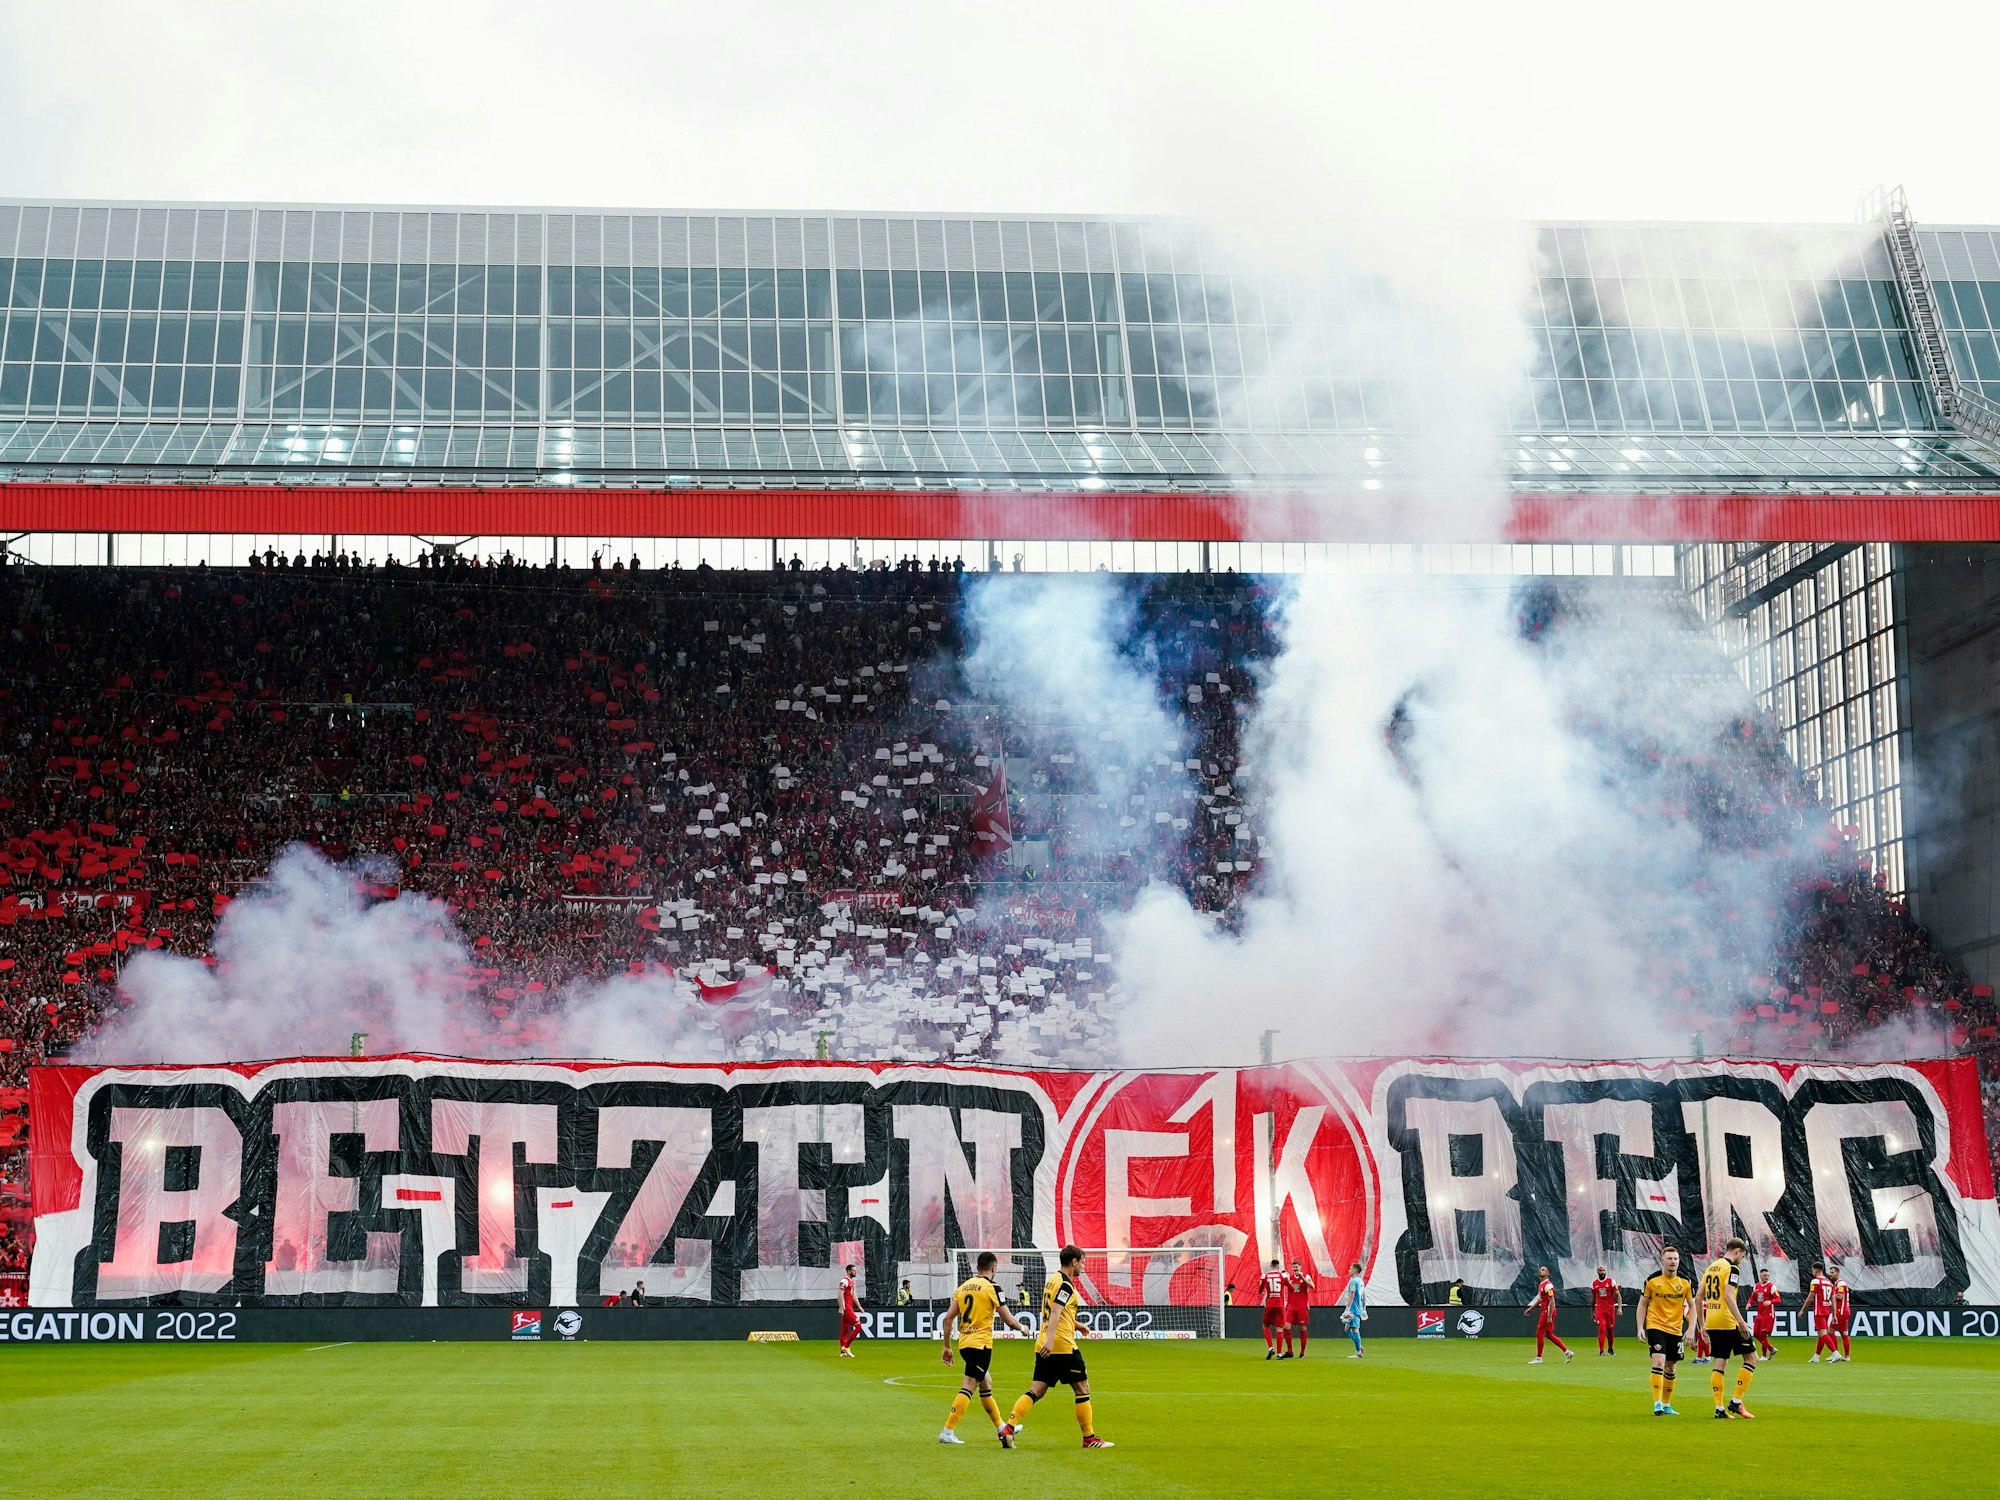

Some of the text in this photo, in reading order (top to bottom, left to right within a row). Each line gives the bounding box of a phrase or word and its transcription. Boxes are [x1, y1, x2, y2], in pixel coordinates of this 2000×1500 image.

[88, 1084, 1036, 1304] BETZEN
[1395, 1084, 1960, 1300] BERG
[1267, 1278, 1282, 1292] 16
[1705, 1274, 1721, 1300] 33
[1822, 1285, 1832, 1300] 19
[962, 1294, 974, 1323] 2
[155, 1311, 237, 1340] 2022
[531, 1323, 540, 1332] 2
[1075, 1310, 1153, 1331] 2022
[1436, 1322, 1444, 1332] 2
[1115, 1331, 1190, 1340] Hotel? trivago
